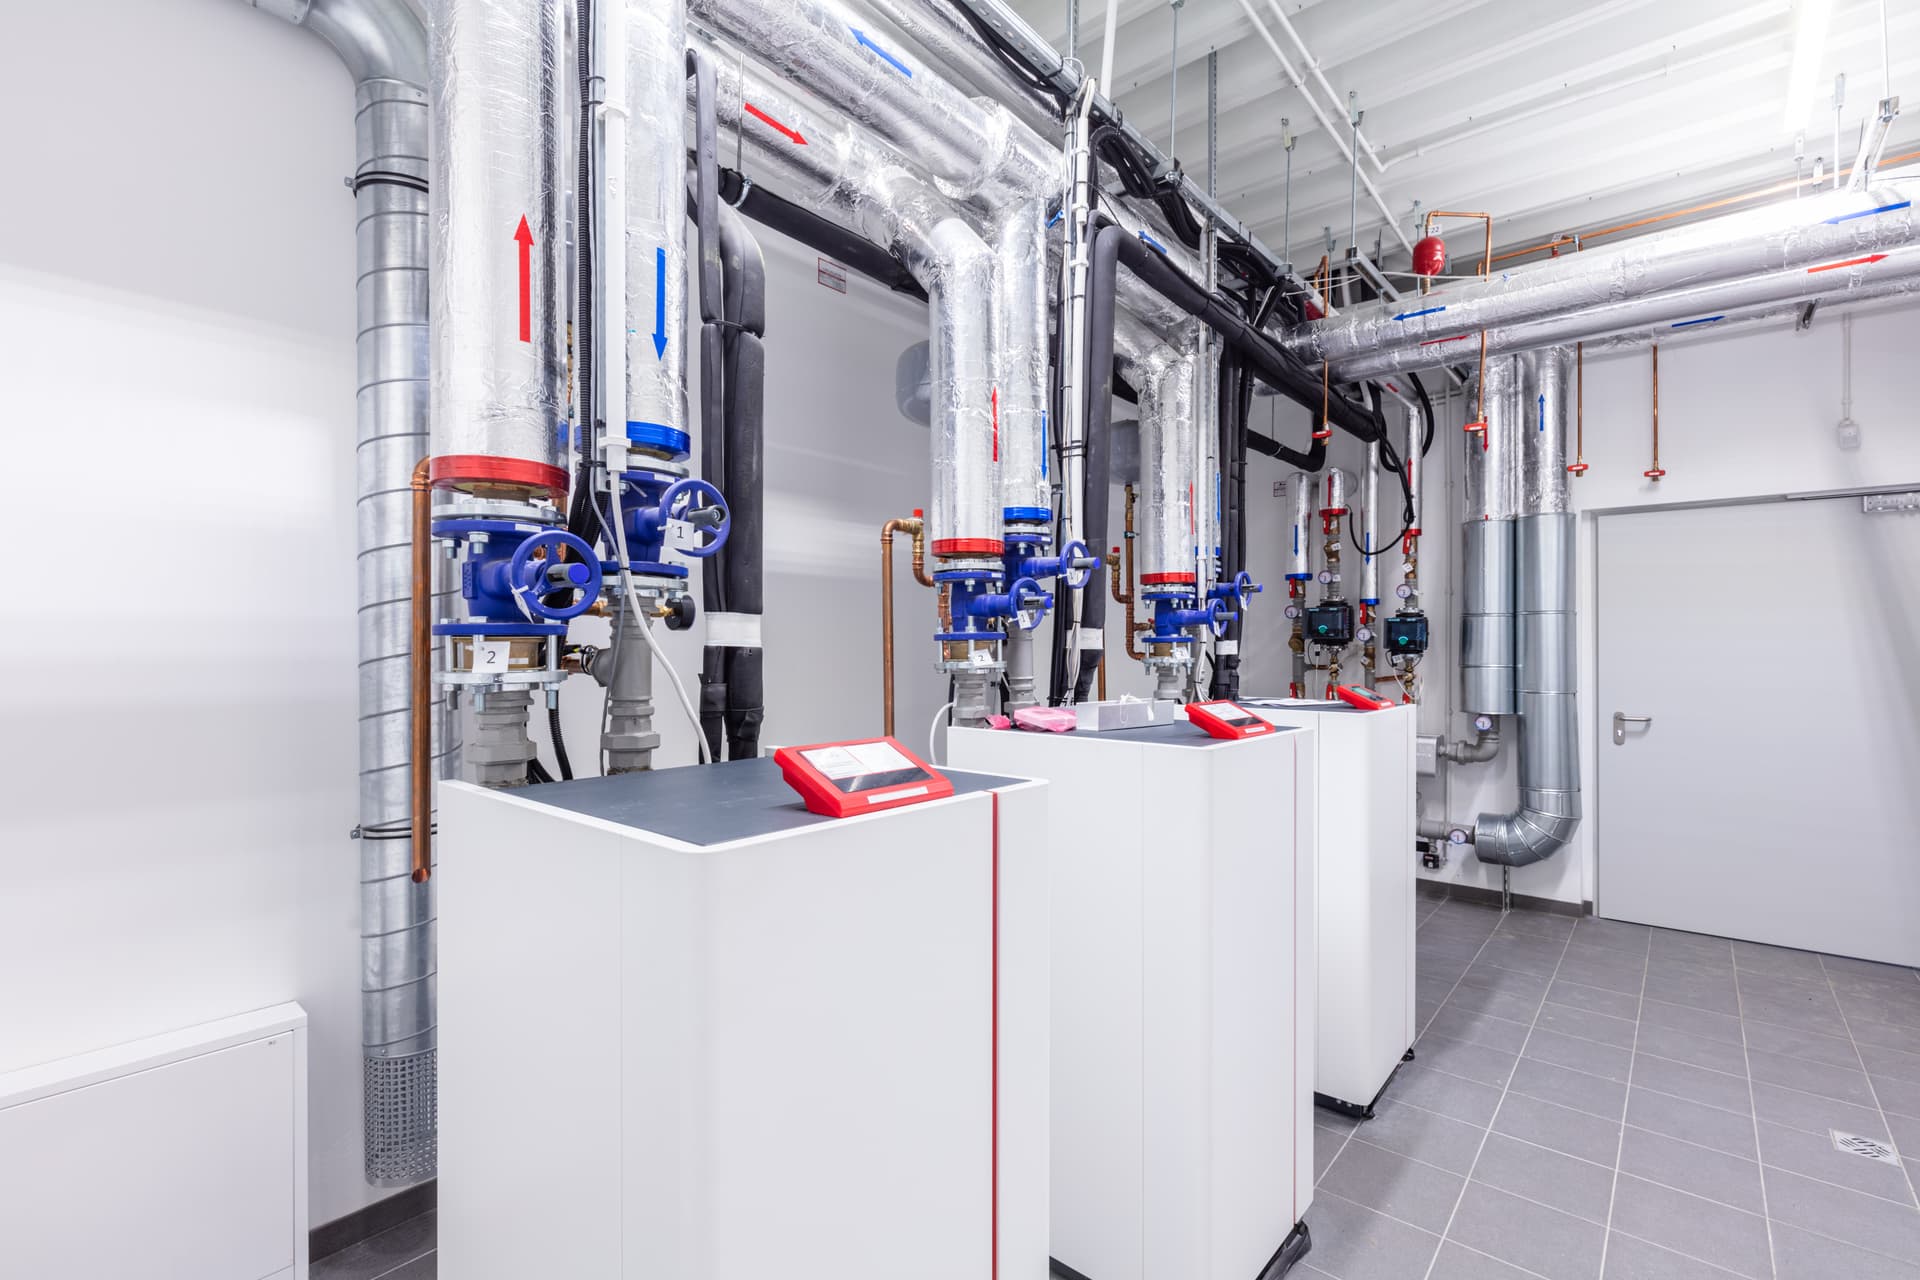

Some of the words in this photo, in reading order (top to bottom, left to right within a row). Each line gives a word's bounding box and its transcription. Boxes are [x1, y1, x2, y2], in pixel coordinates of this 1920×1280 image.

[676, 526, 684, 539] 1
[486, 650, 496, 664] 2
[978, 654, 985, 662] 2
